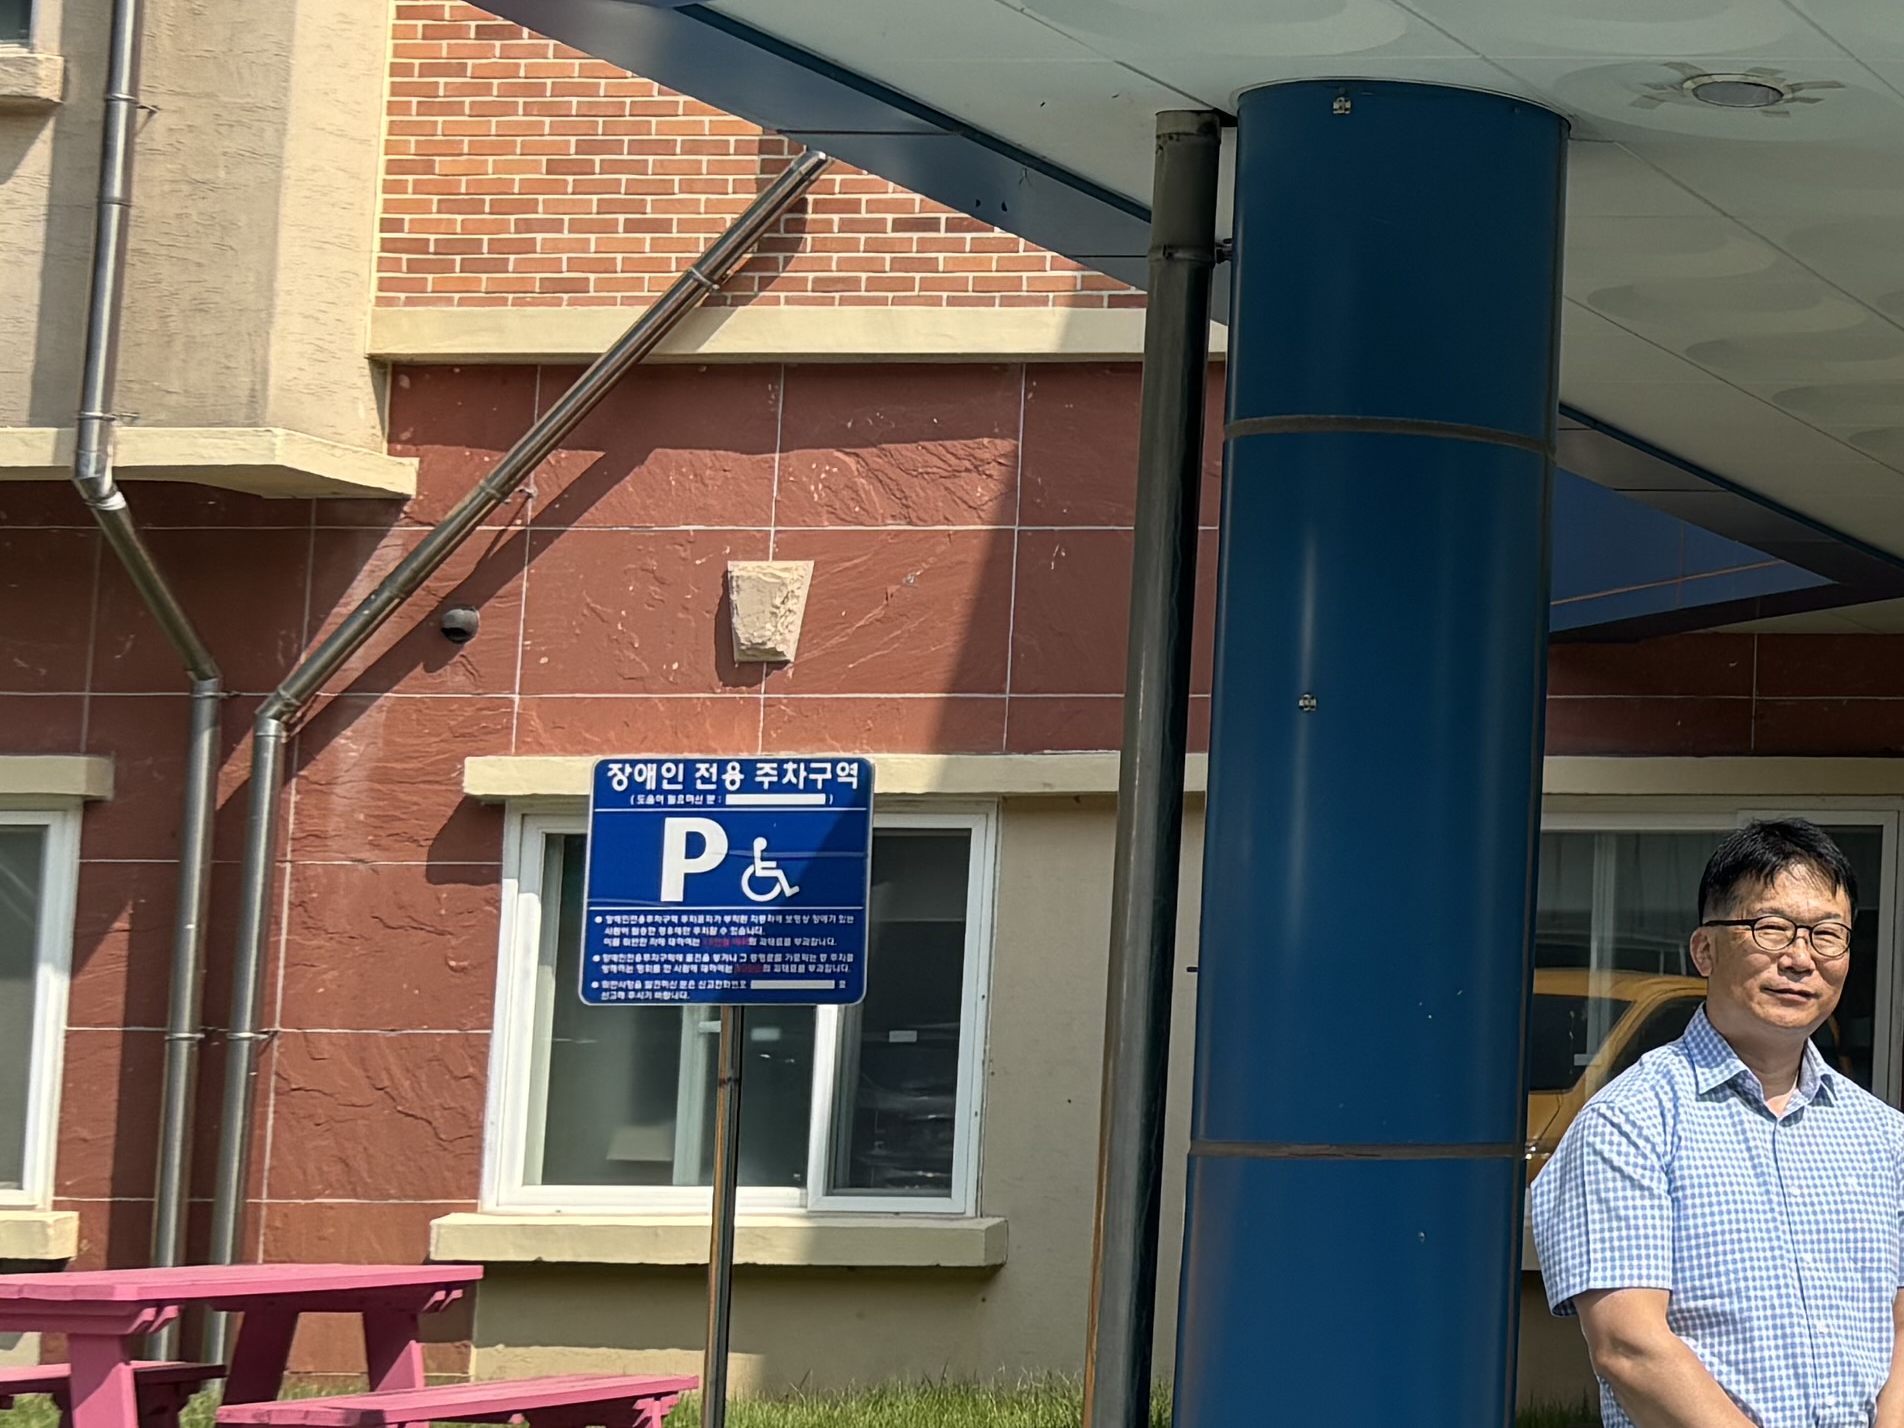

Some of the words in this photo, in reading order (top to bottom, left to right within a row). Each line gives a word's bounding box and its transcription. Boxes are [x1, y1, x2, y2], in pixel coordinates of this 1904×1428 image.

[607, 762, 684, 791] 장애인
[695, 761, 745, 790] 전용
[754, 761, 859, 790] 주차구역
[660, 817, 728, 902] P
